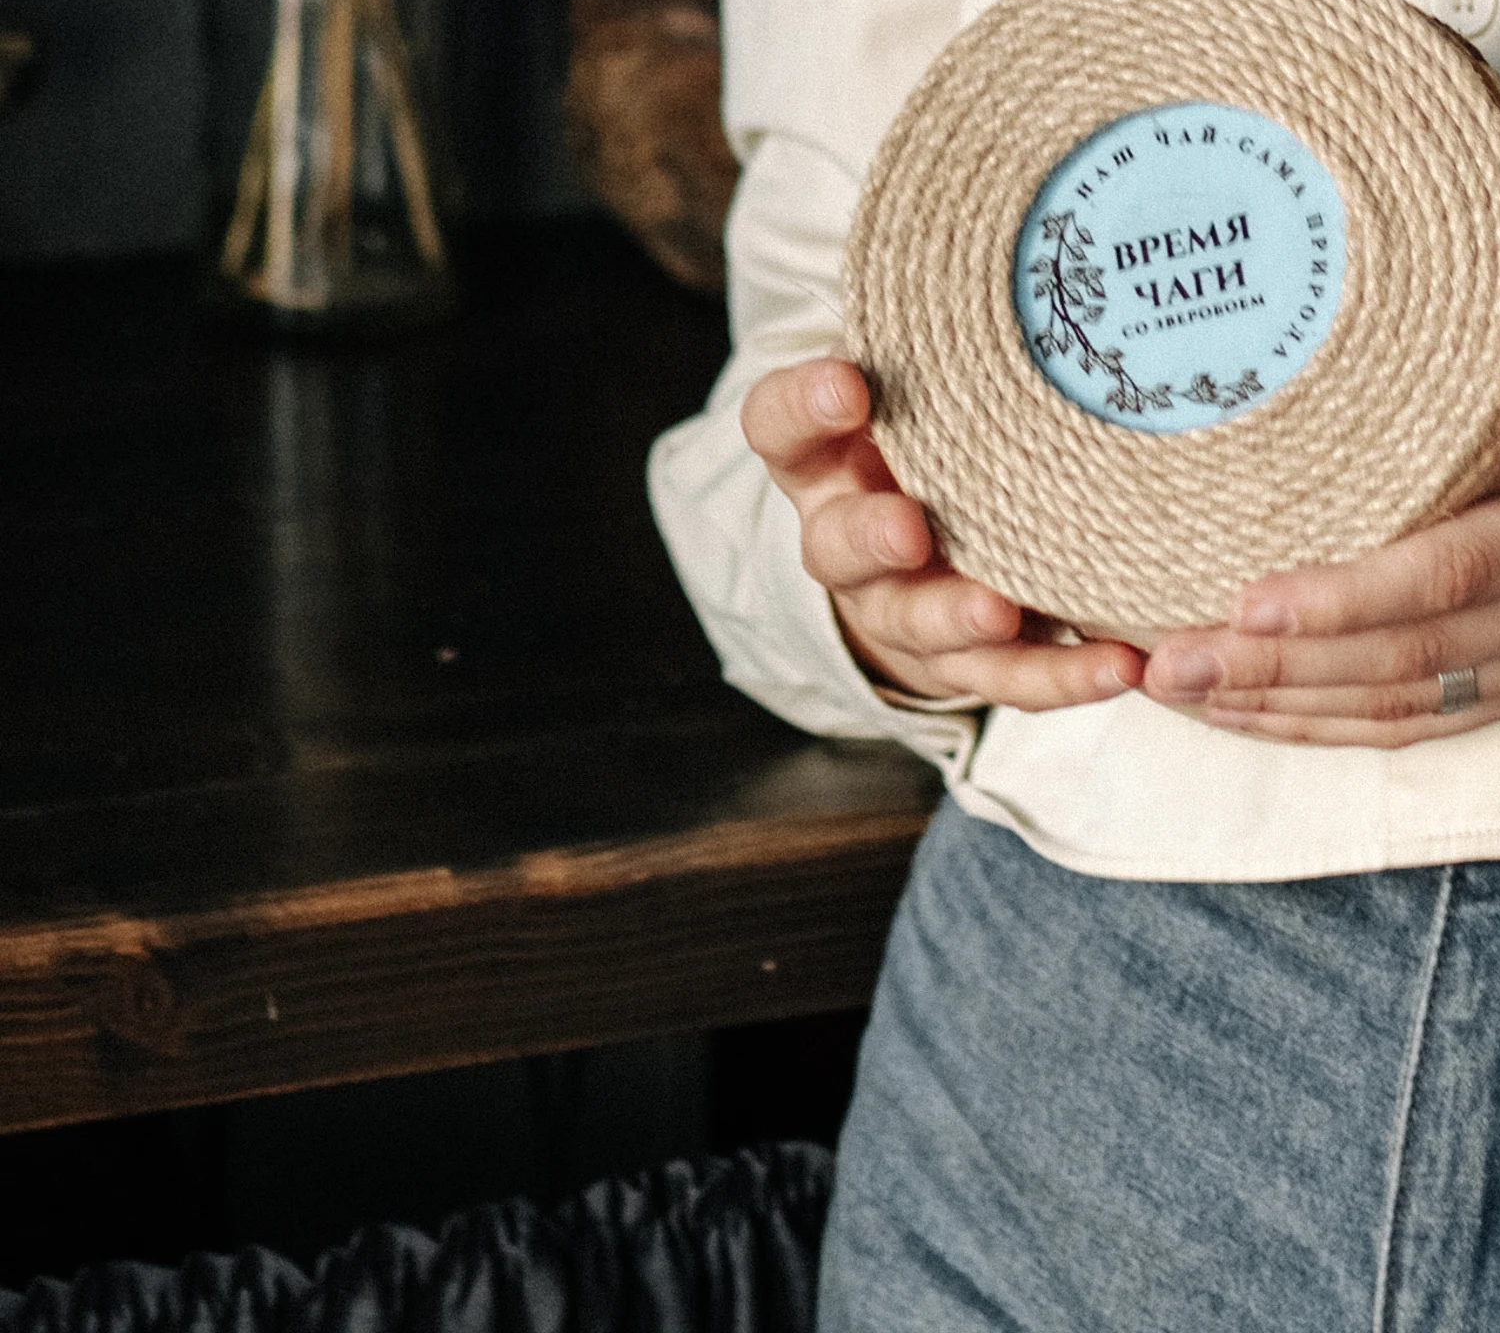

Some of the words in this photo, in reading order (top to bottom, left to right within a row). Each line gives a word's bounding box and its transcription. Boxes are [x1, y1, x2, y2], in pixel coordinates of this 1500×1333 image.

[1075, 146, 1134, 200] НАШ
[1155, 124, 1217, 146] ЧАЙ
[1238, 136, 1306, 200] САМА
[1273, 211, 1328, 358] ПРИРОДА
[1112, 212, 1251, 271] ВРЕМЯ
[1134, 259, 1246, 308] ЧАГИ
[1121, 320, 1149, 340] СО
